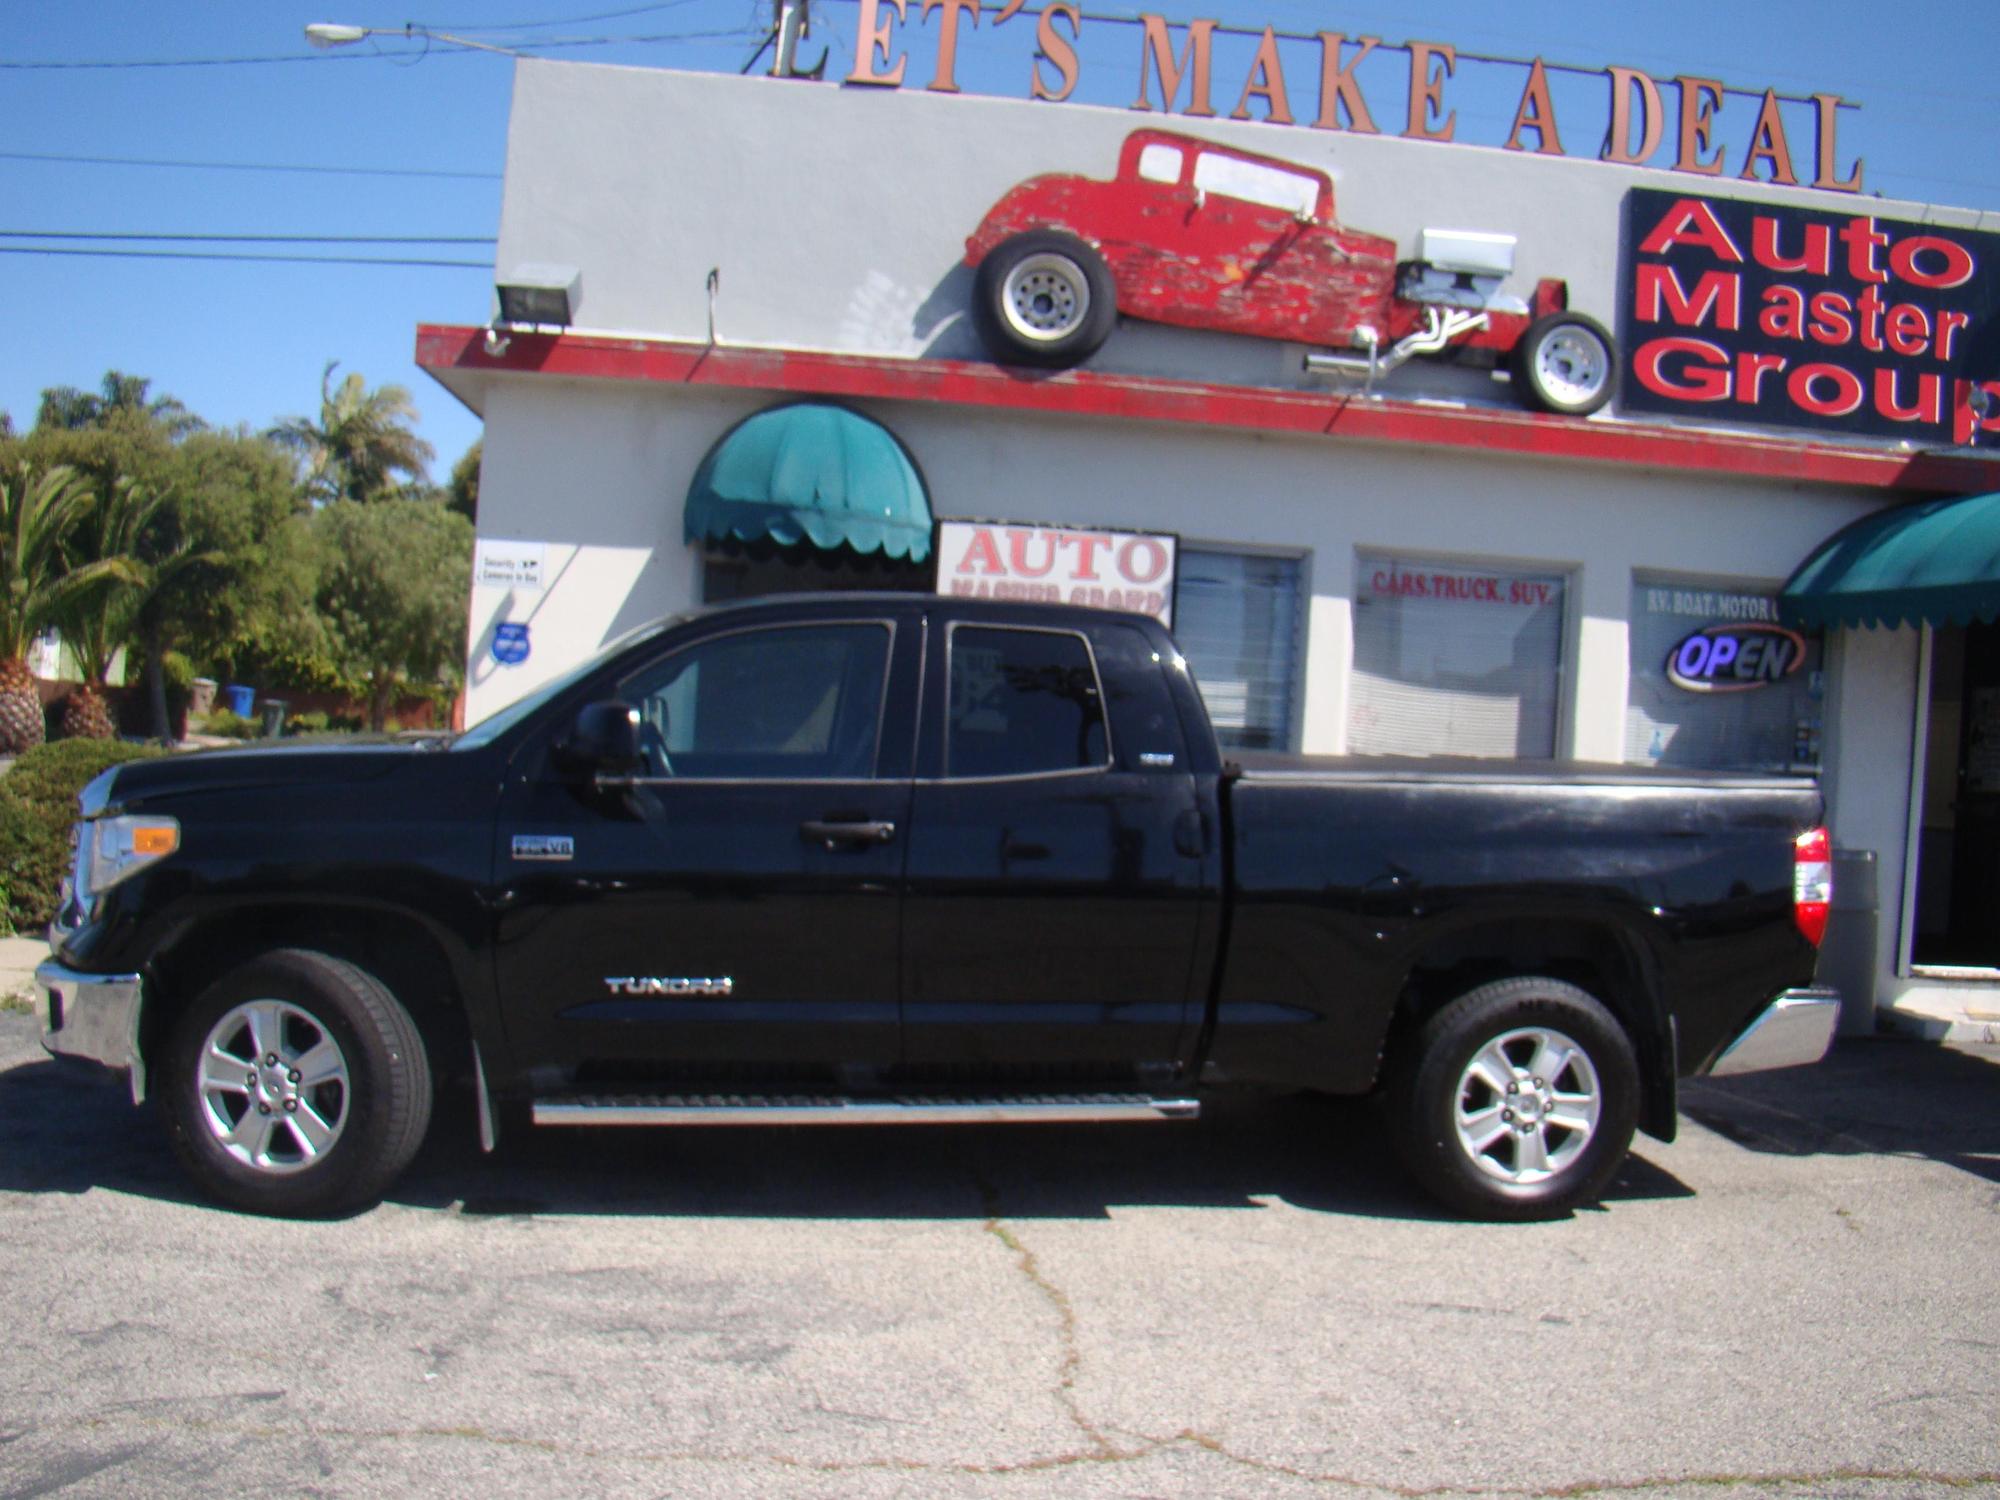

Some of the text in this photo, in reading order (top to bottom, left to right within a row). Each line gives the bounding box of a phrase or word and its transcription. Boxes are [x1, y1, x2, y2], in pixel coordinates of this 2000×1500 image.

[1132, 14, 1457, 142] MAKE
[1503, 56, 1566, 155] A
[1601, 66, 1863, 194] DEAL
[1639, 198, 1974, 288] Auto
[1635, 264, 1968, 360] Master
[1632, 337, 2000, 446] Group
[956, 528, 1168, 583] AUTO
[1677, 634, 1792, 681] OPEN
[604, 977, 733, 995] TUNDRA
